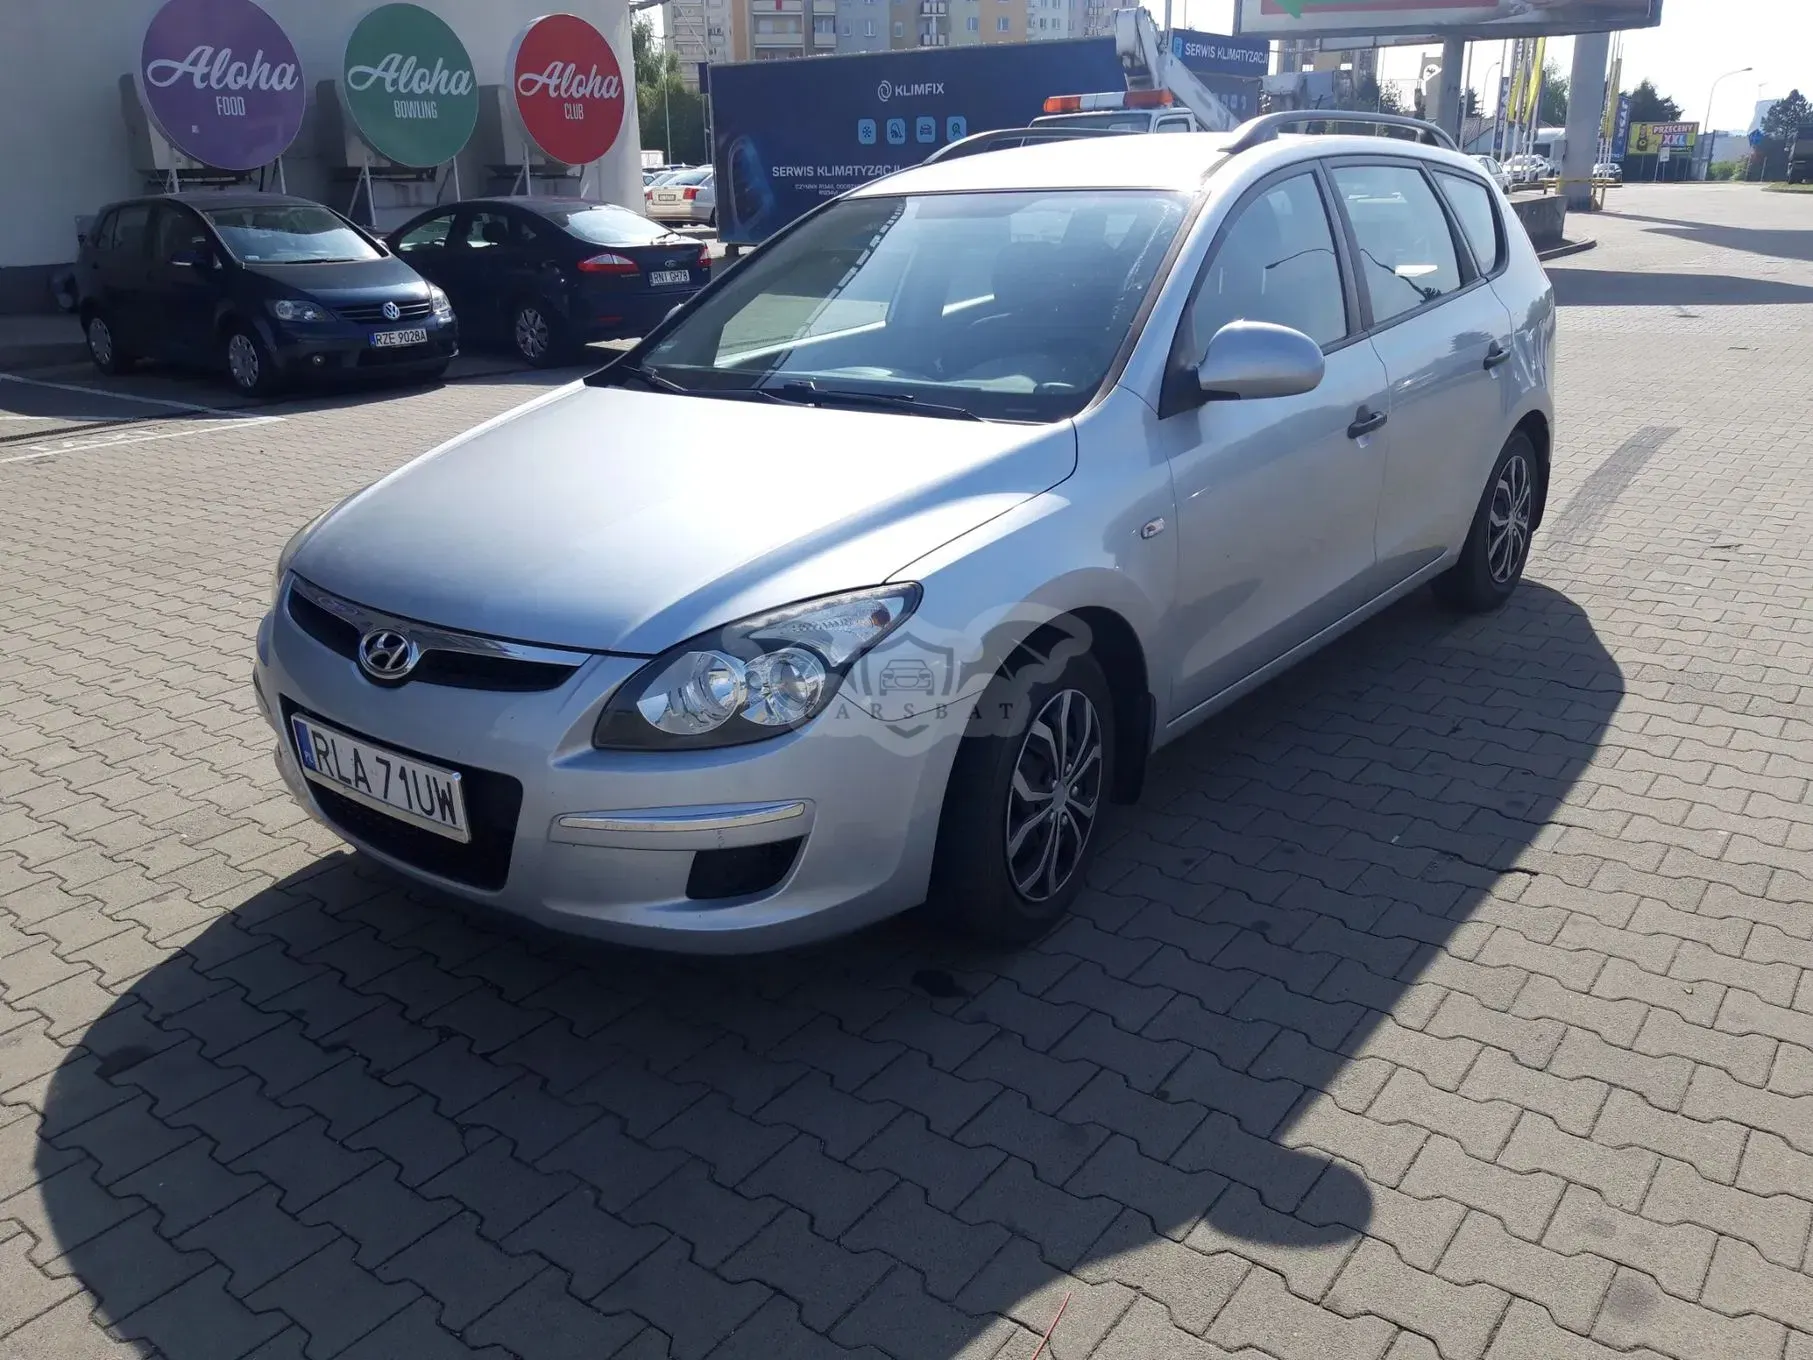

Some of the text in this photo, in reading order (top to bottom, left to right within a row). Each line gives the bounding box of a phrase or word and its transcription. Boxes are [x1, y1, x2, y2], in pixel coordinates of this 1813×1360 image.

[1185, 43, 1215, 58] SERWIS
[146, 45, 298, 91] Aloha
[348, 52, 473, 96] Aloha
[518, 61, 620, 100] Aloha
[895, 82, 945, 97] KLIMFIX
[217, 96, 245, 116] FOOD
[394, 99, 438, 120] BOWLING
[564, 103, 584, 120] CLUB
[1653, 124, 1693, 134] PRZECENY
[1663, 134, 1685, 146] XXL
[772, 166, 814, 177] SERWIS
[654, 272, 668, 283] RNI
[375, 330, 427, 345] RZE 9028A
[311, 730, 457, 825] RLA 71UW
